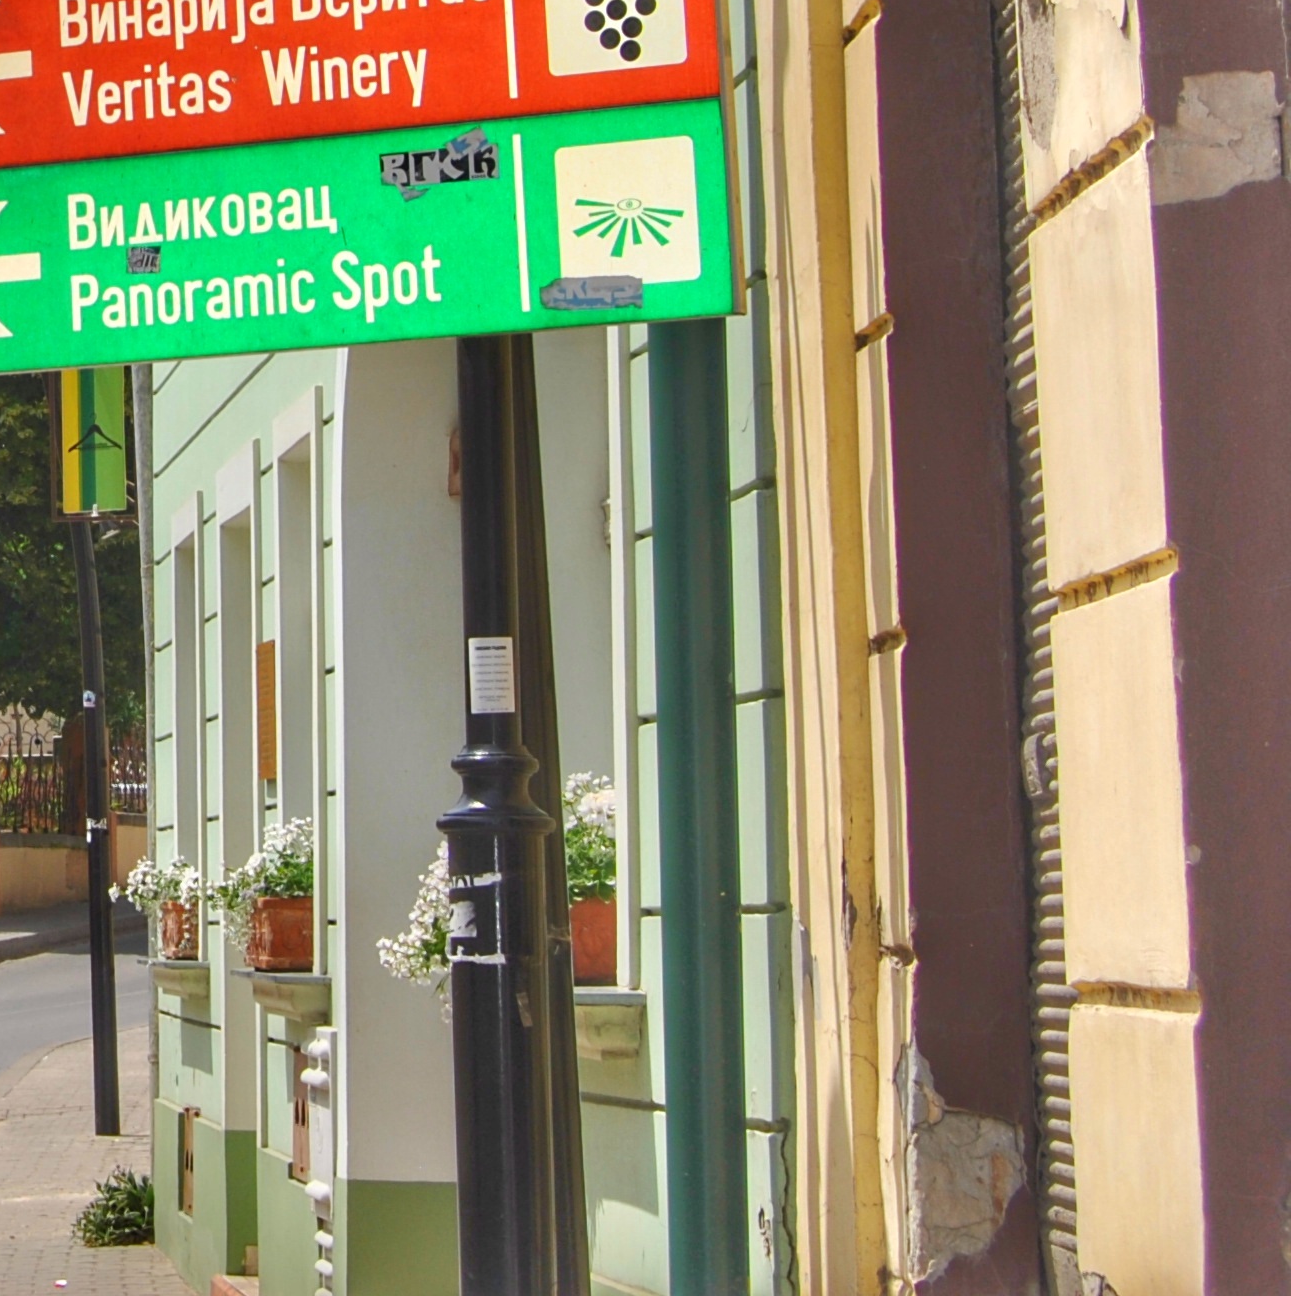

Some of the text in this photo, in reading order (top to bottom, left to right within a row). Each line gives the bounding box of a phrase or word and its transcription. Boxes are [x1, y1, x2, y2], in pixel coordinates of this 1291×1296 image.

[62, 45, 427, 127] Veritas Winery
[67, 185, 338, 251] Видиковац
[70, 244, 442, 332] Panoramic Spot
